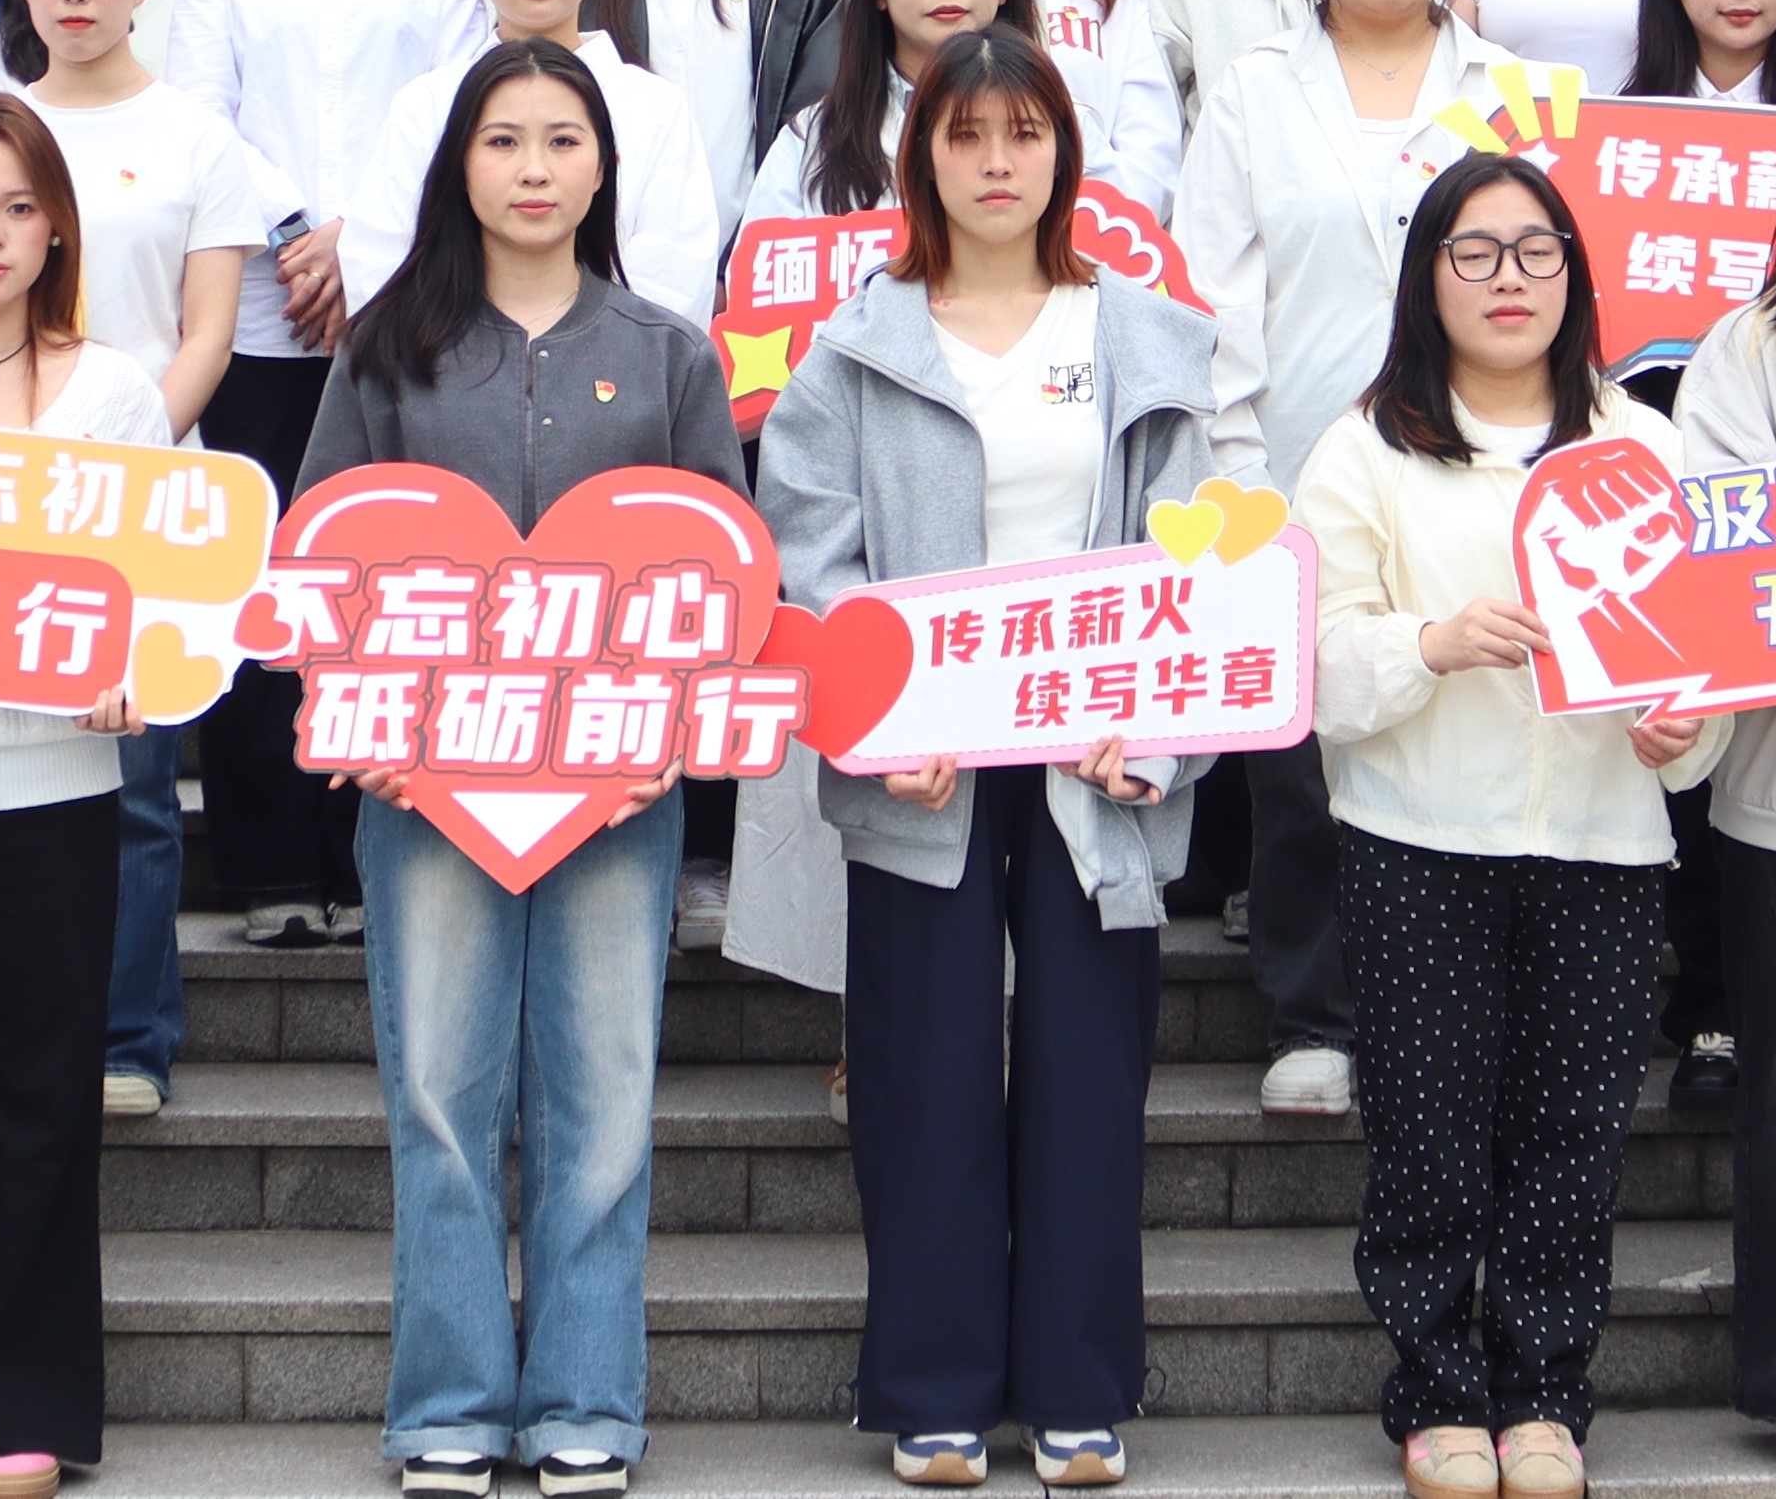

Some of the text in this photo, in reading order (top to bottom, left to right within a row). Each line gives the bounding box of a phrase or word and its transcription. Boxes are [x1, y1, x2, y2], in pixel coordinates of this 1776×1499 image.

[751, 228, 895, 308] 缅怀
[1625, 231, 1772, 302] 续写
[267, 567, 727, 660] 不忘初心
[929, 575, 1194, 669] 传承薪火
[307, 670, 800, 766] 砥砺前行
[1014, 645, 1278, 730] 续写华章
